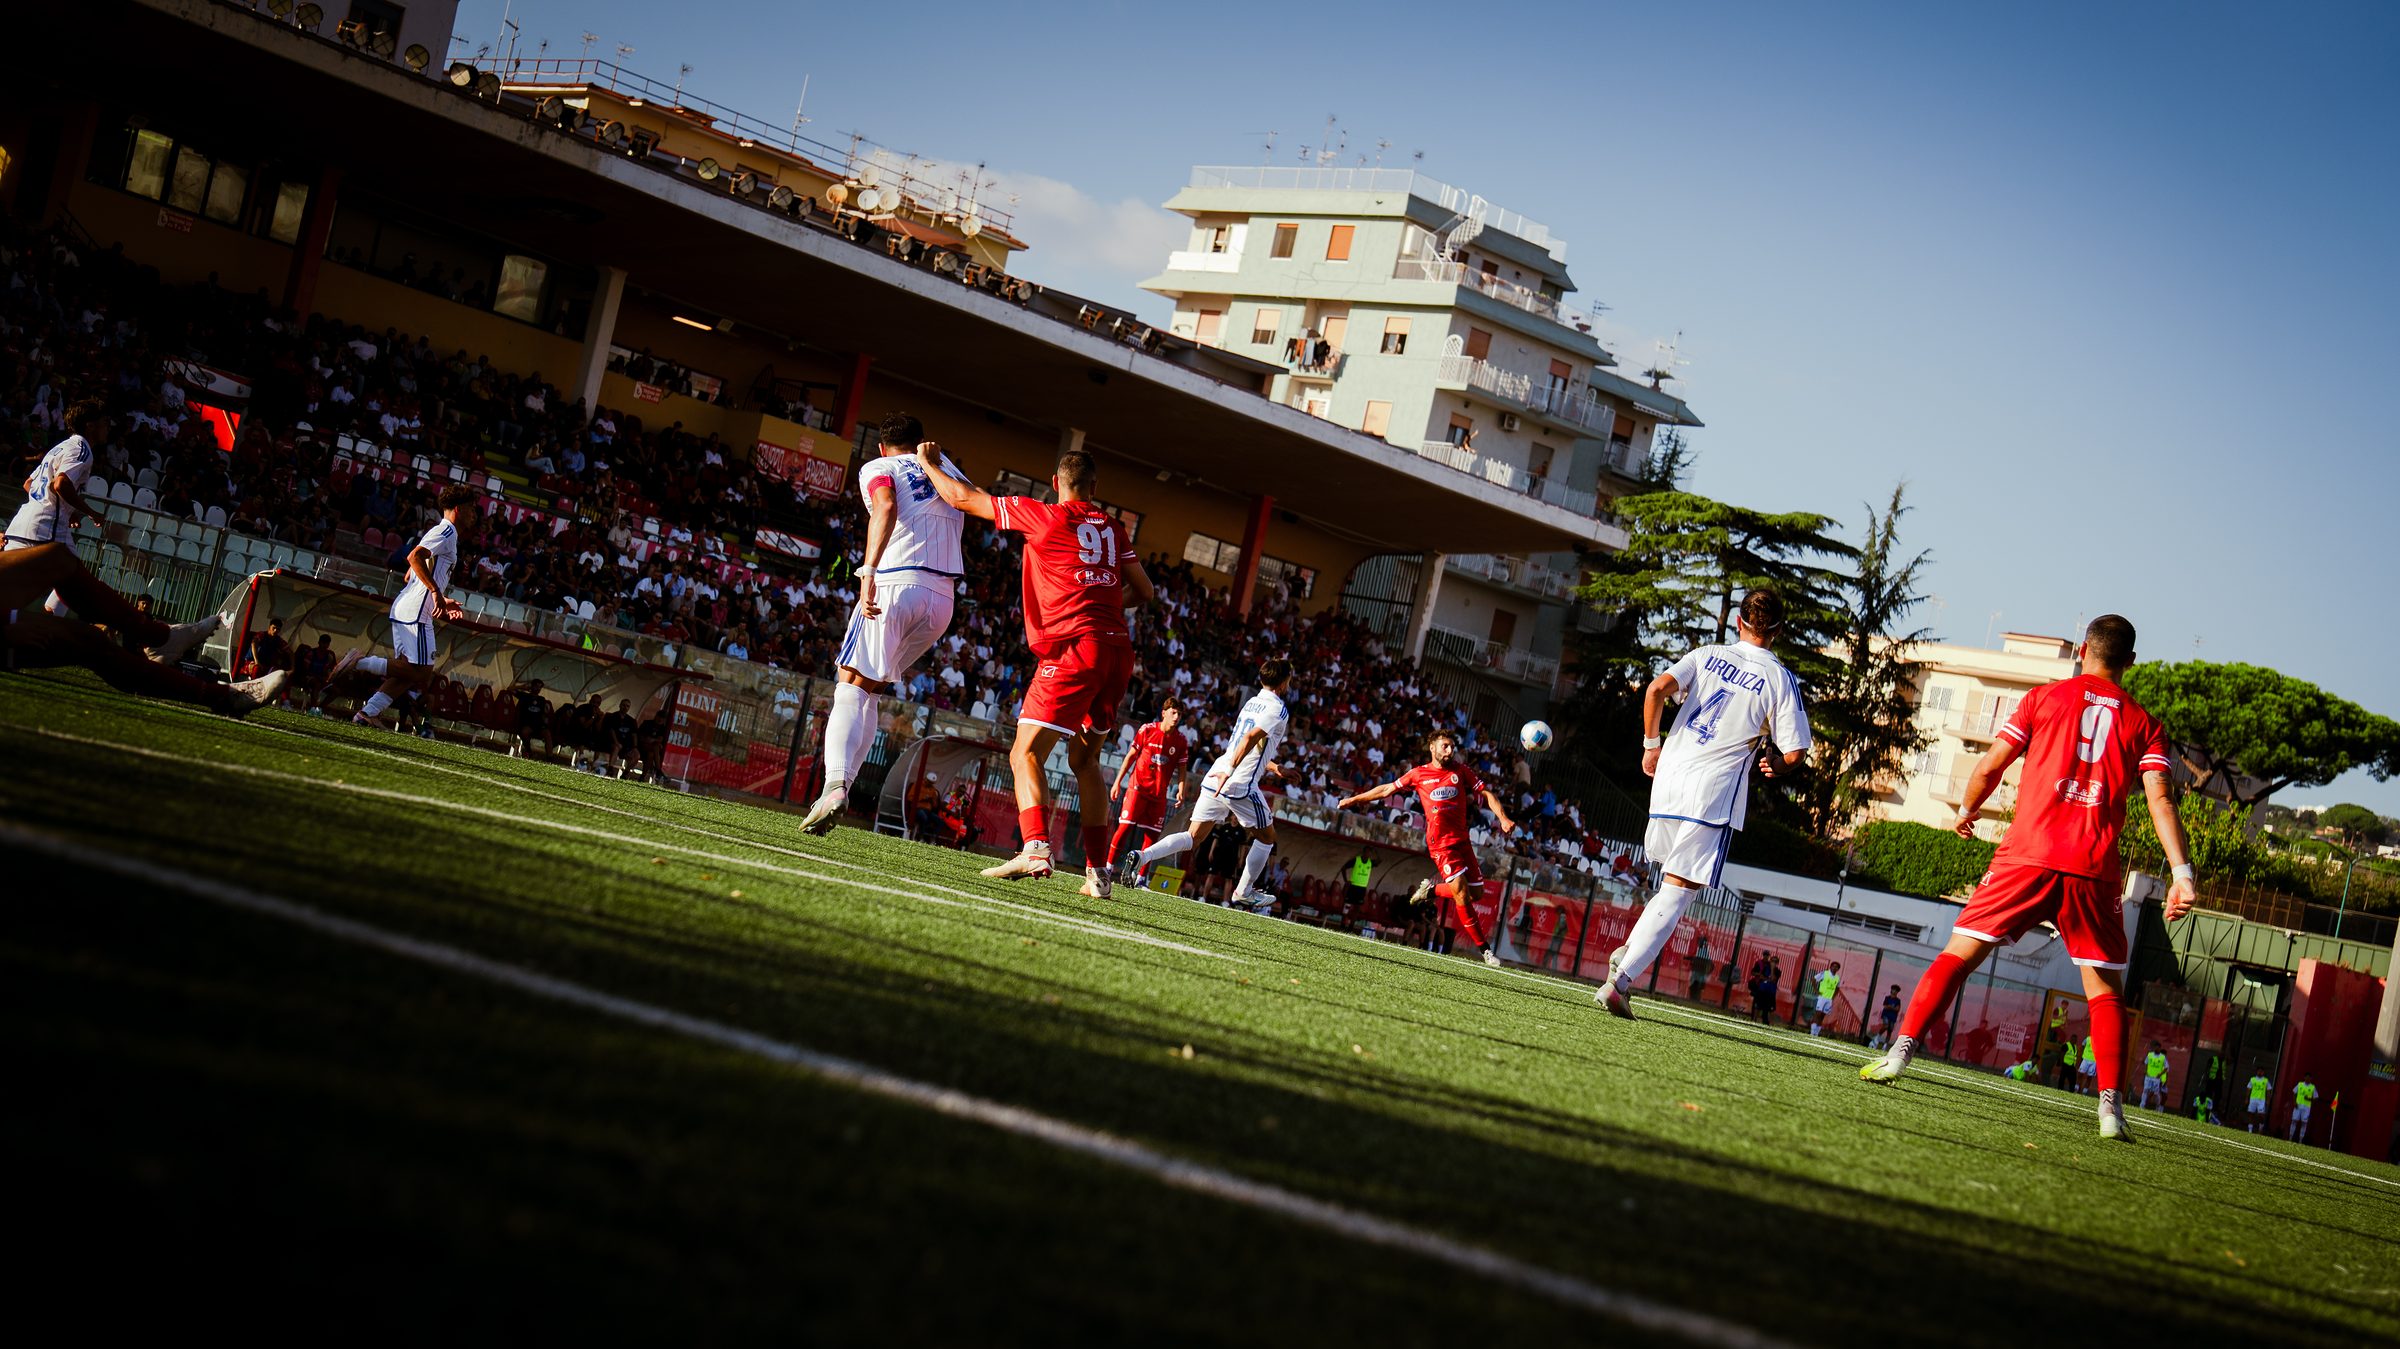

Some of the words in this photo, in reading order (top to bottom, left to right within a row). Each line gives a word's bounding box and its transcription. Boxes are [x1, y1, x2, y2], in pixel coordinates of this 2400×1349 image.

[1076, 523, 1116, 568] 91
[1704, 655, 1766, 696] URQUIZA
[1685, 686, 1736, 746] 4
[2077, 704, 2113, 764] 9
